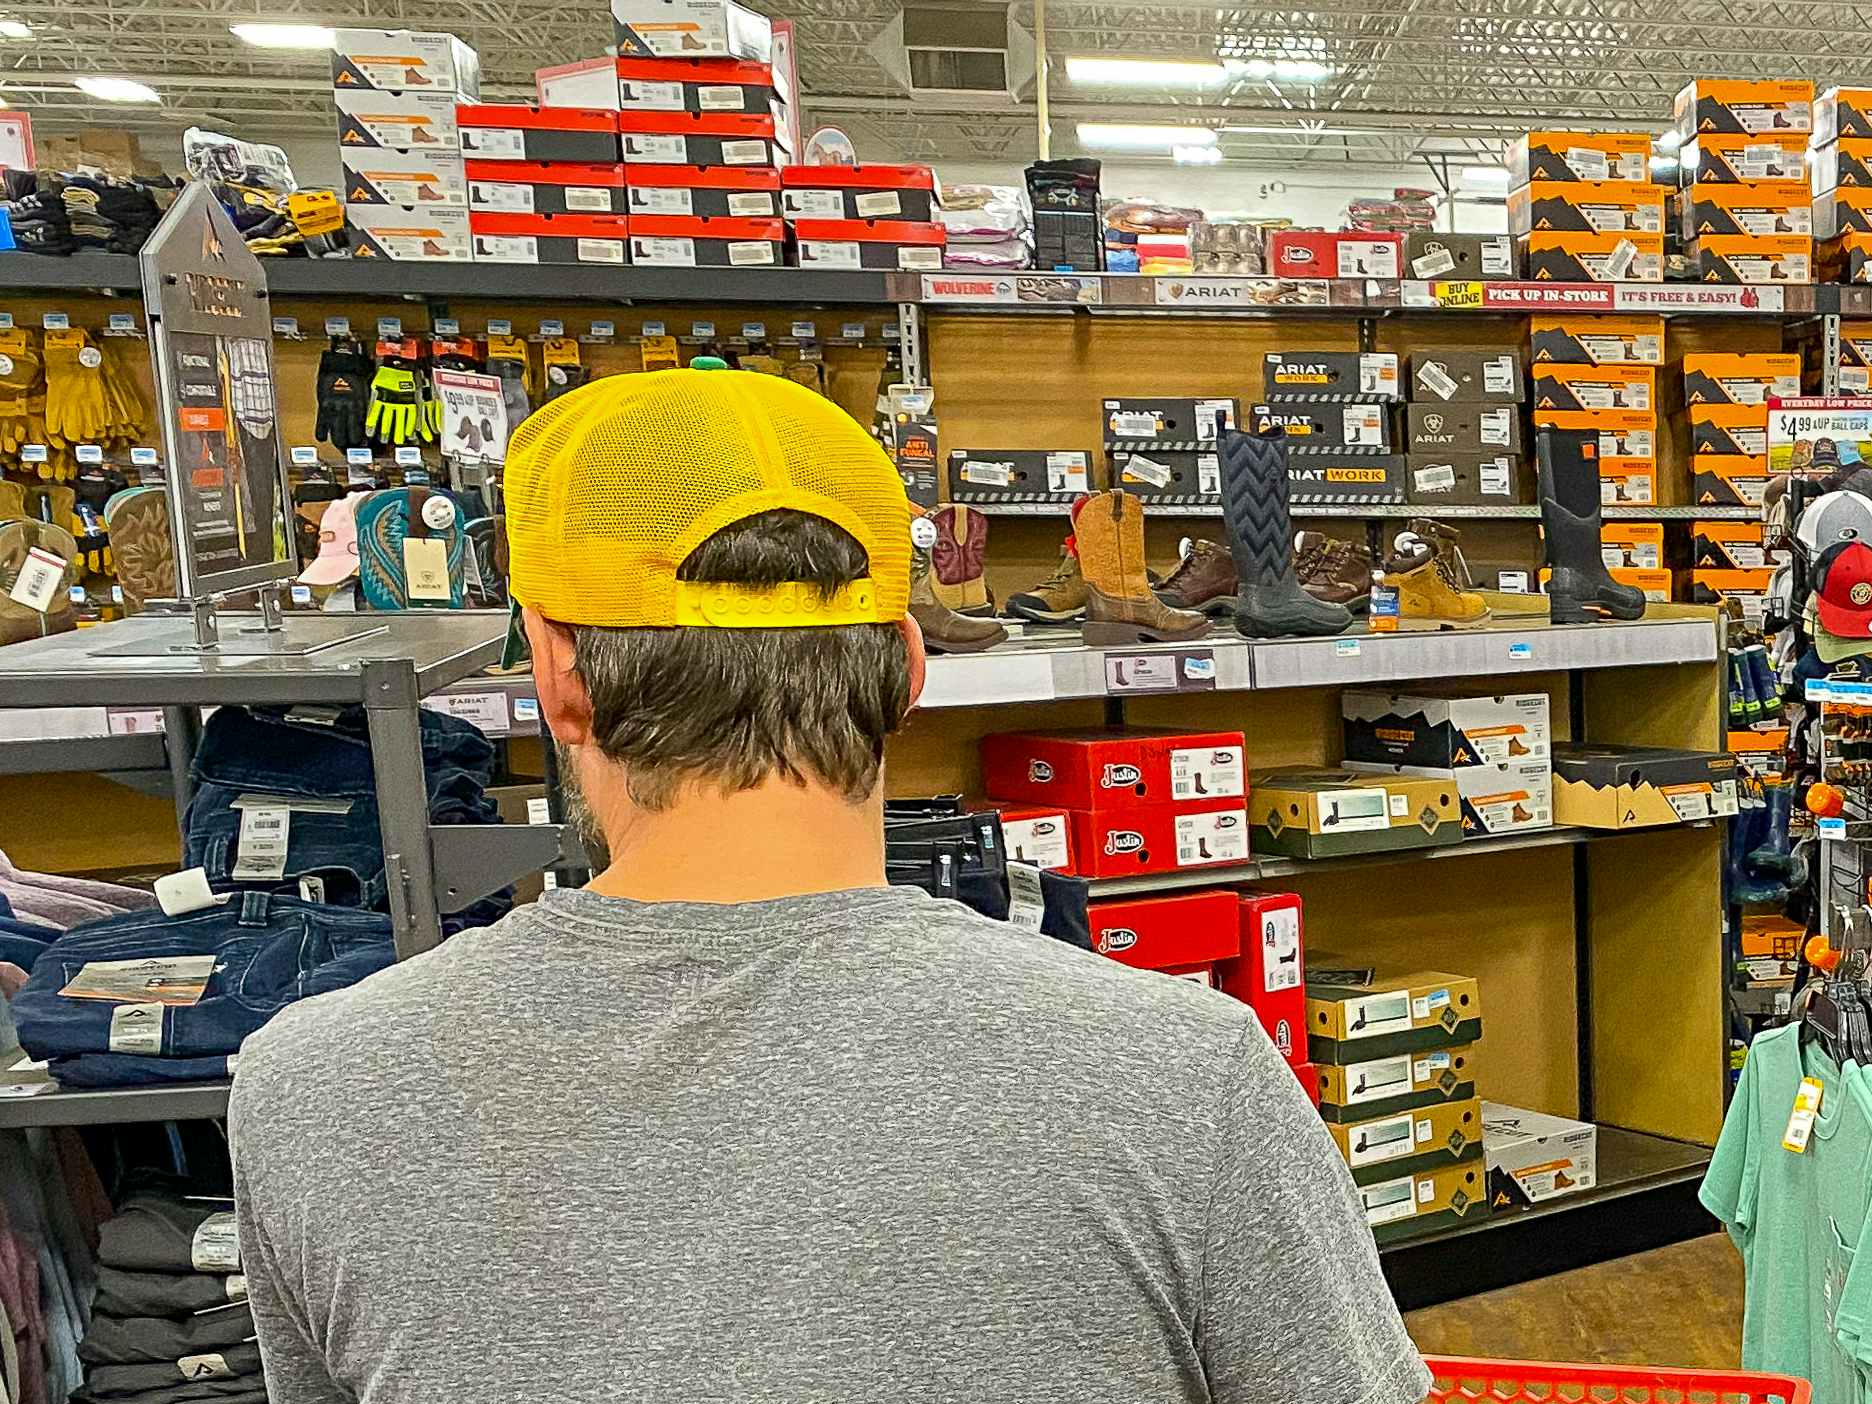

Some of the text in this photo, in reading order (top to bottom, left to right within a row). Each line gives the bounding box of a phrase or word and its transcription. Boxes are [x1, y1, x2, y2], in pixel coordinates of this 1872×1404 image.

[932, 281, 995, 296] WOLVERINE
[1185, 286, 1242, 297] ARIAT
[1448, 283, 1470, 296] BUY
[1488, 289, 1609, 303] PICK UP IN-STORE
[1621, 292, 1738, 304] IT'S FREE & EASY!
[1275, 364, 1328, 375] ARIAT
[1781, 399, 1872, 408] EVERYDAY LOW PRICE
[1258, 415, 1312, 425] ARIAT
[1415, 434, 1454, 443] ARIAT
[1288, 469, 1384, 480] RIAT WORK
[1102, 764, 1140, 788] Justin
[1105, 831, 1144, 855] Justin
[1099, 929, 1137, 953] Justin
